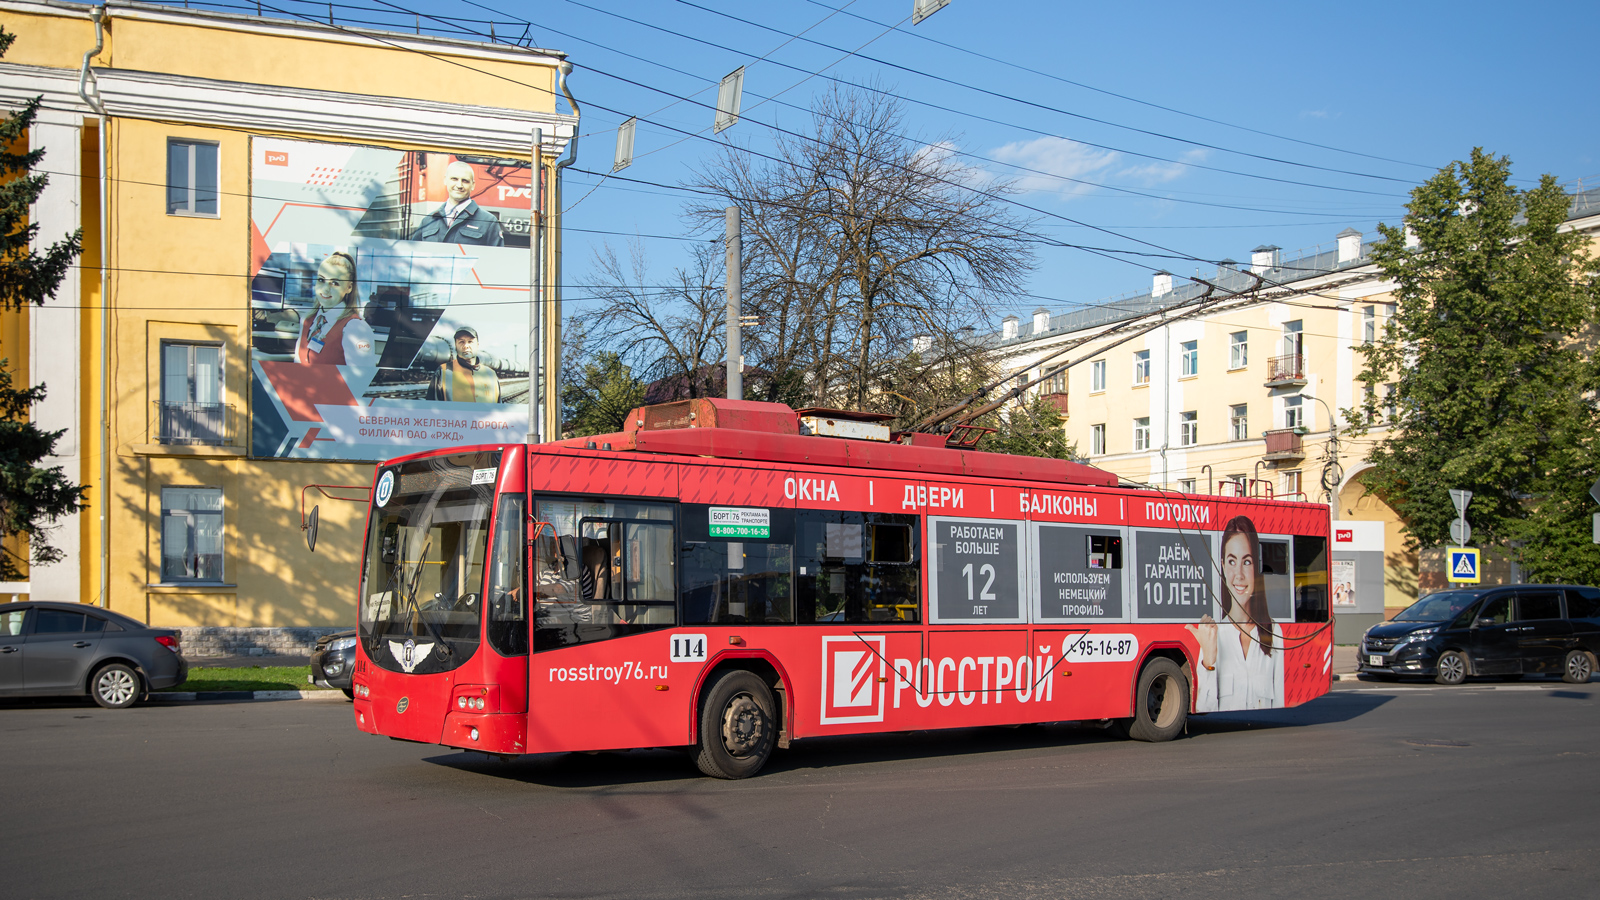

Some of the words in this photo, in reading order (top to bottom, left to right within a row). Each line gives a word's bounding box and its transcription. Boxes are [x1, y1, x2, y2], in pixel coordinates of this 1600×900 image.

[358, 415, 410, 426] СЕВЕРНАЯ
[413, 418, 467, 428] ЖЕЛЕЗНАЯ
[470, 420, 509, 430] ДОРОГА
[358, 427, 403, 438] ФИЛИАЛ
[406, 430, 427, 439] ОАО
[430, 431, 464, 441] «РЖД»
[784, 478, 840, 502] ОКНА
[902, 485, 964, 510] ДВЕРИ
[1019, 493, 1097, 517] БАЛКОНЫ
[1146, 502, 1210, 523] ПОТОЛКИ
[716, 527, 768, 536] 8-800-700-16-36
[950, 525, 1004, 540] РАБОТАЕМ
[955, 541, 1000, 555] БОЛЬШЕ
[1158, 543, 1190, 563] ДАЁМ
[1053, 572, 1110, 584] ИСПОЛЬЗУЕМ
[1145, 564, 1204, 580] ГАРАНТИЮ
[962, 563, 996, 600] 12
[1059, 587, 1106, 601] НЕМЕЦКИЙ
[1143, 582, 1163, 605] 10
[1167, 582, 1207, 605] ЛЕТ!
[972, 605, 988, 615] ЛЕТ
[1062, 605, 1104, 616] ПРОФИЛЬ
[673, 639, 705, 658] 114
[1079, 640, 1132, 656] 95-16-87
[357, 660, 367, 672] 114
[549, 661, 668, 685] rosstroy76.ru
[893, 645, 1053, 708] РОССТРОЙ
